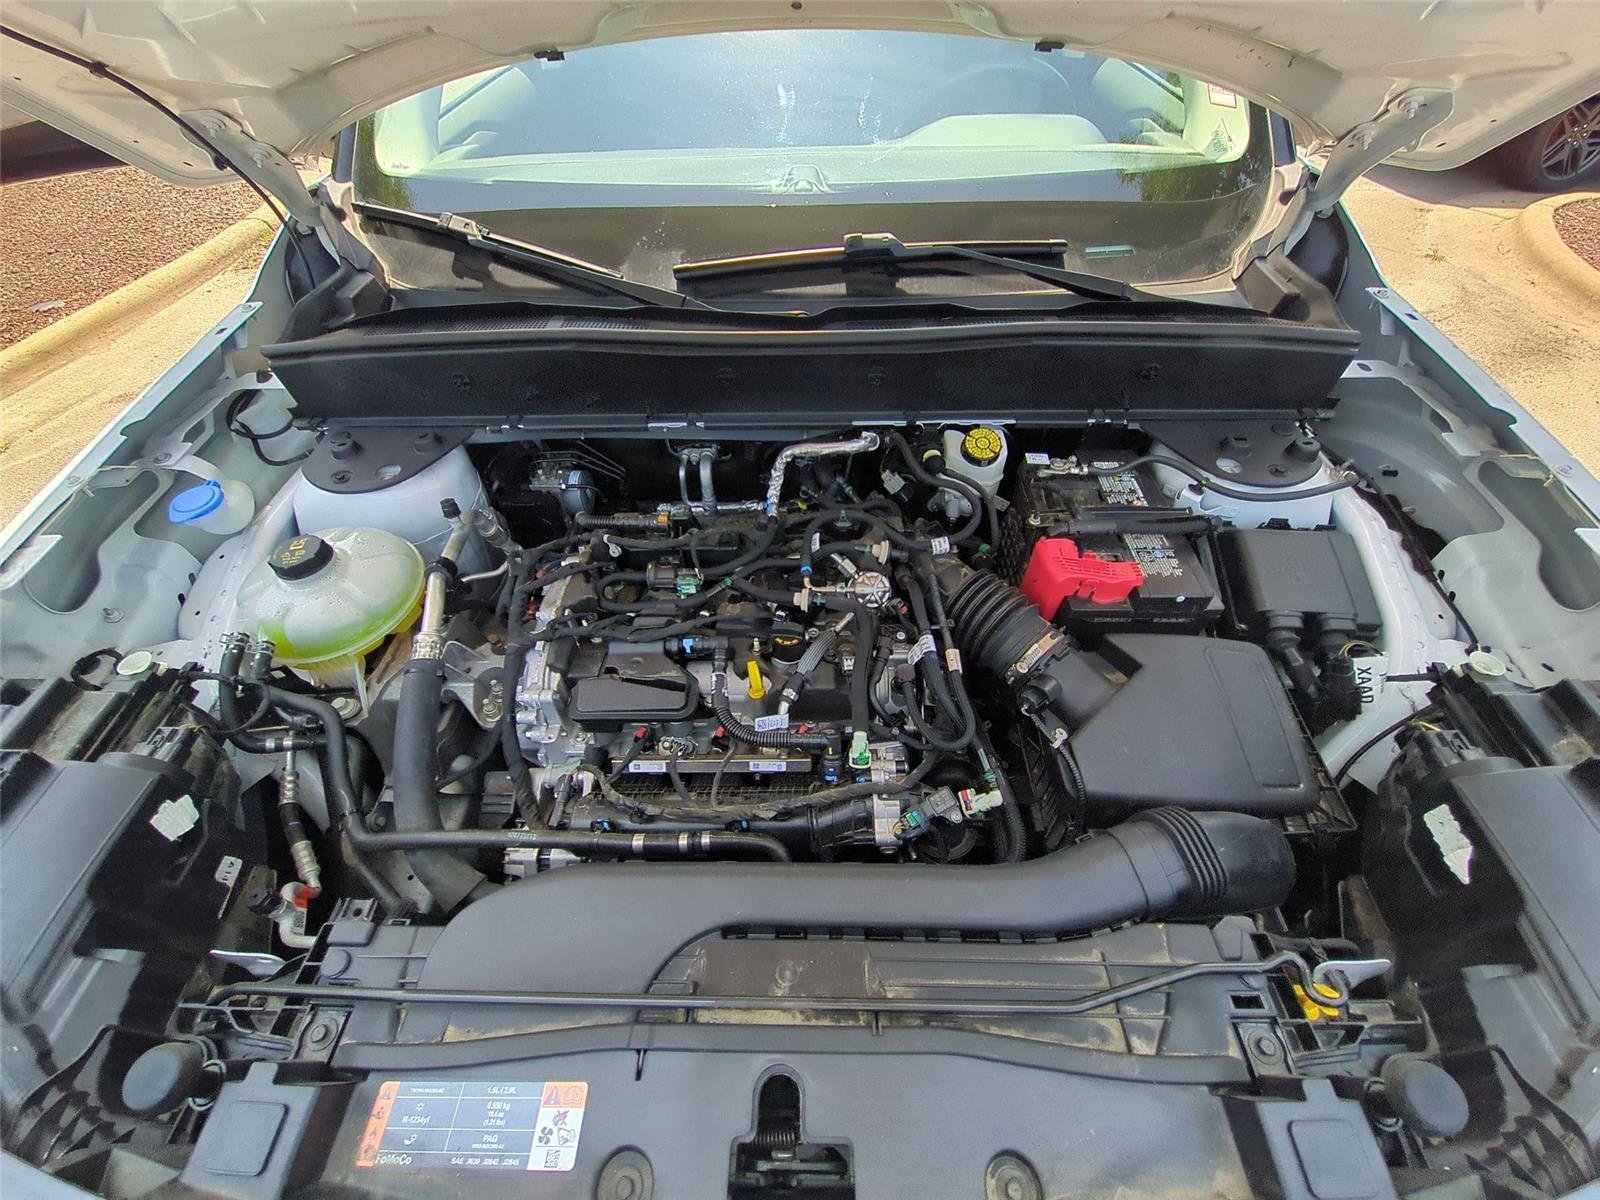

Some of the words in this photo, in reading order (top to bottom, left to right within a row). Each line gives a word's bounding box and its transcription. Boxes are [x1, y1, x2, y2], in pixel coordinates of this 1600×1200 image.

[1356, 666, 1374, 703] XAAD
[402, 1115, 431, 1125] R-1234yf
[482, 1134, 498, 1143] PAG
[375, 1154, 412, 1165] FoMoCo
[451, 1157, 464, 1165] SAE
